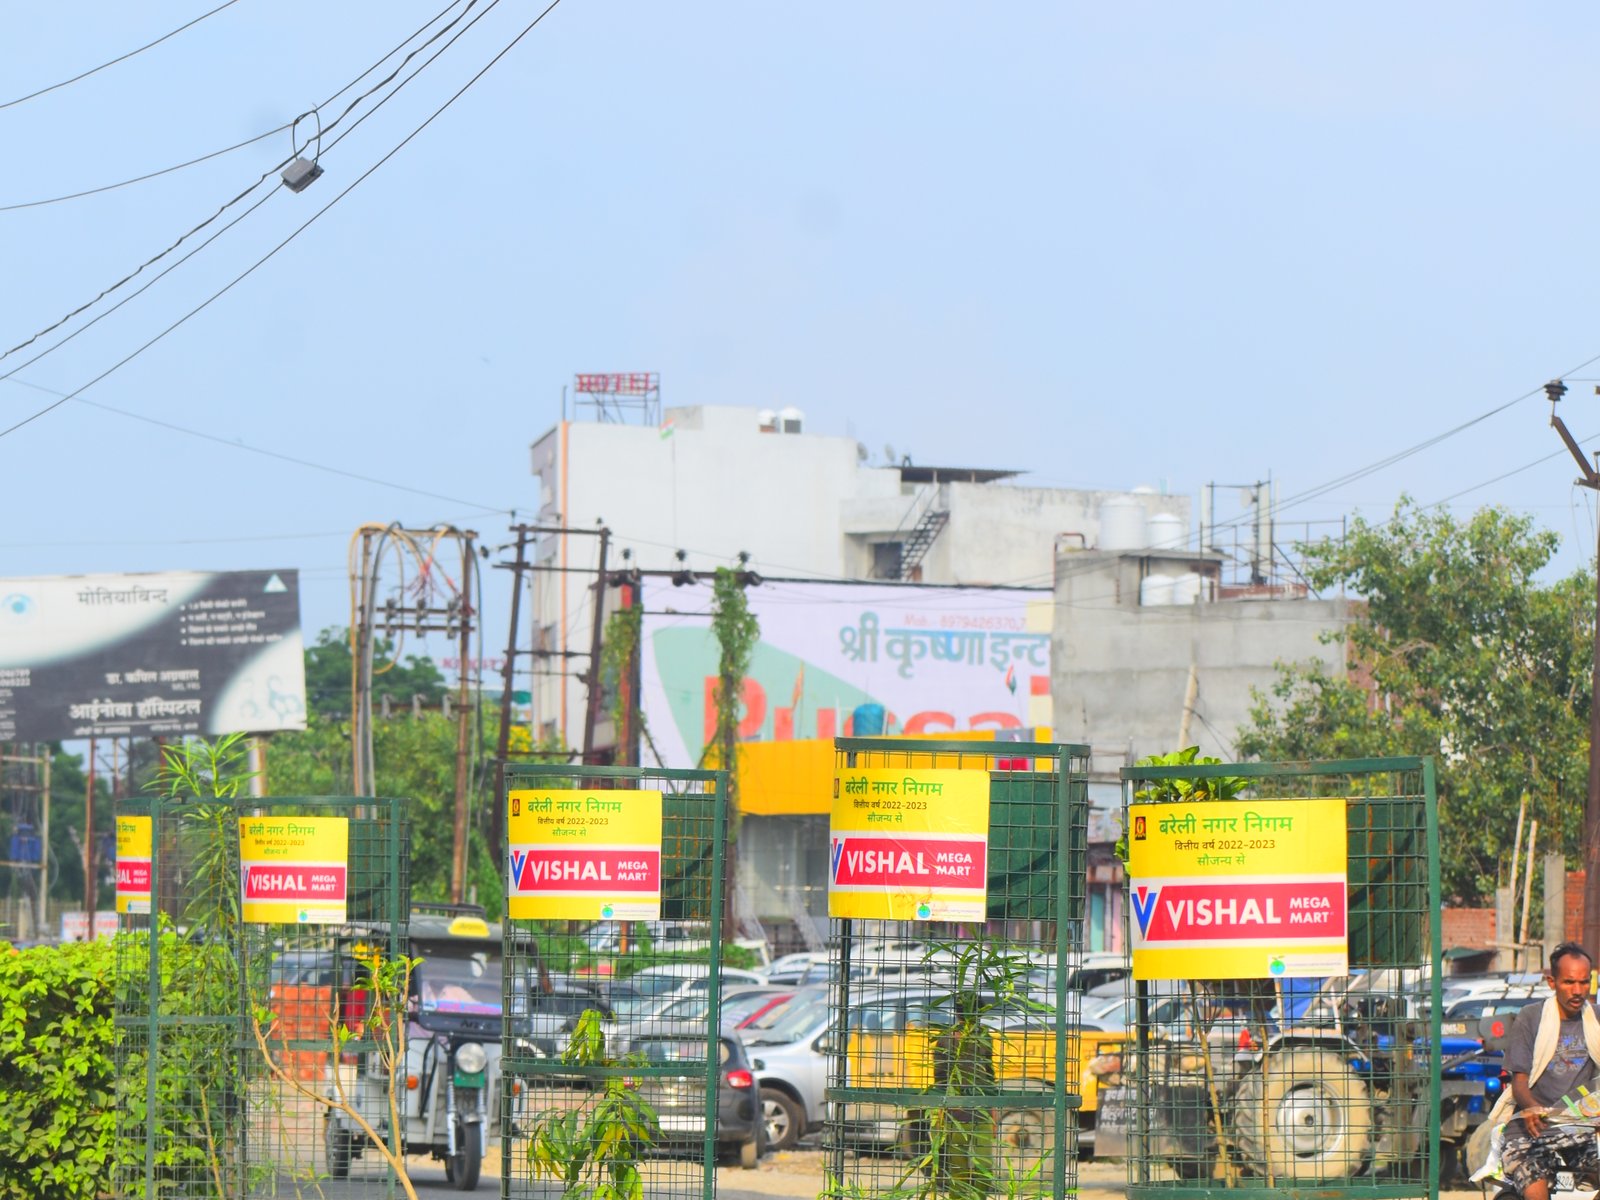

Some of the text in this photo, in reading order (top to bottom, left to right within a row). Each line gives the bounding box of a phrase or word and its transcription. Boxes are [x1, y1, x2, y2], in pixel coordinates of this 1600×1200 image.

[839, 611, 879, 662] श्री
[845, 776, 943, 796] बरेली नगर निगम
[527, 797, 622, 813] बरेली नगर निगम
[882, 801, 927, 810] 2022-2023
[895, 812, 903, 823] से
[1159, 811, 1293, 834] बरेली नगर निगम
[266, 825, 284, 835] नगर
[287, 823, 315, 836] निगम
[1174, 839, 1276, 851] वित्तीय वर्ष 2022-2023
[847, 850, 930, 877] VISHAL
[936, 852, 973, 864] MEGA
[1197, 853, 1246, 866] सौजन्य से
[530, 860, 612, 884] VISHAL
[617, 861, 648, 870] MEGA
[618, 872, 647, 881] MART
[936, 866, 971, 876] MART
[251, 874, 337, 893] VISHAL MEGA
[1166, 898, 1281, 932] VISHAL
[1289, 897, 1330, 909] MEGA
[1289, 911, 1329, 924] MART
